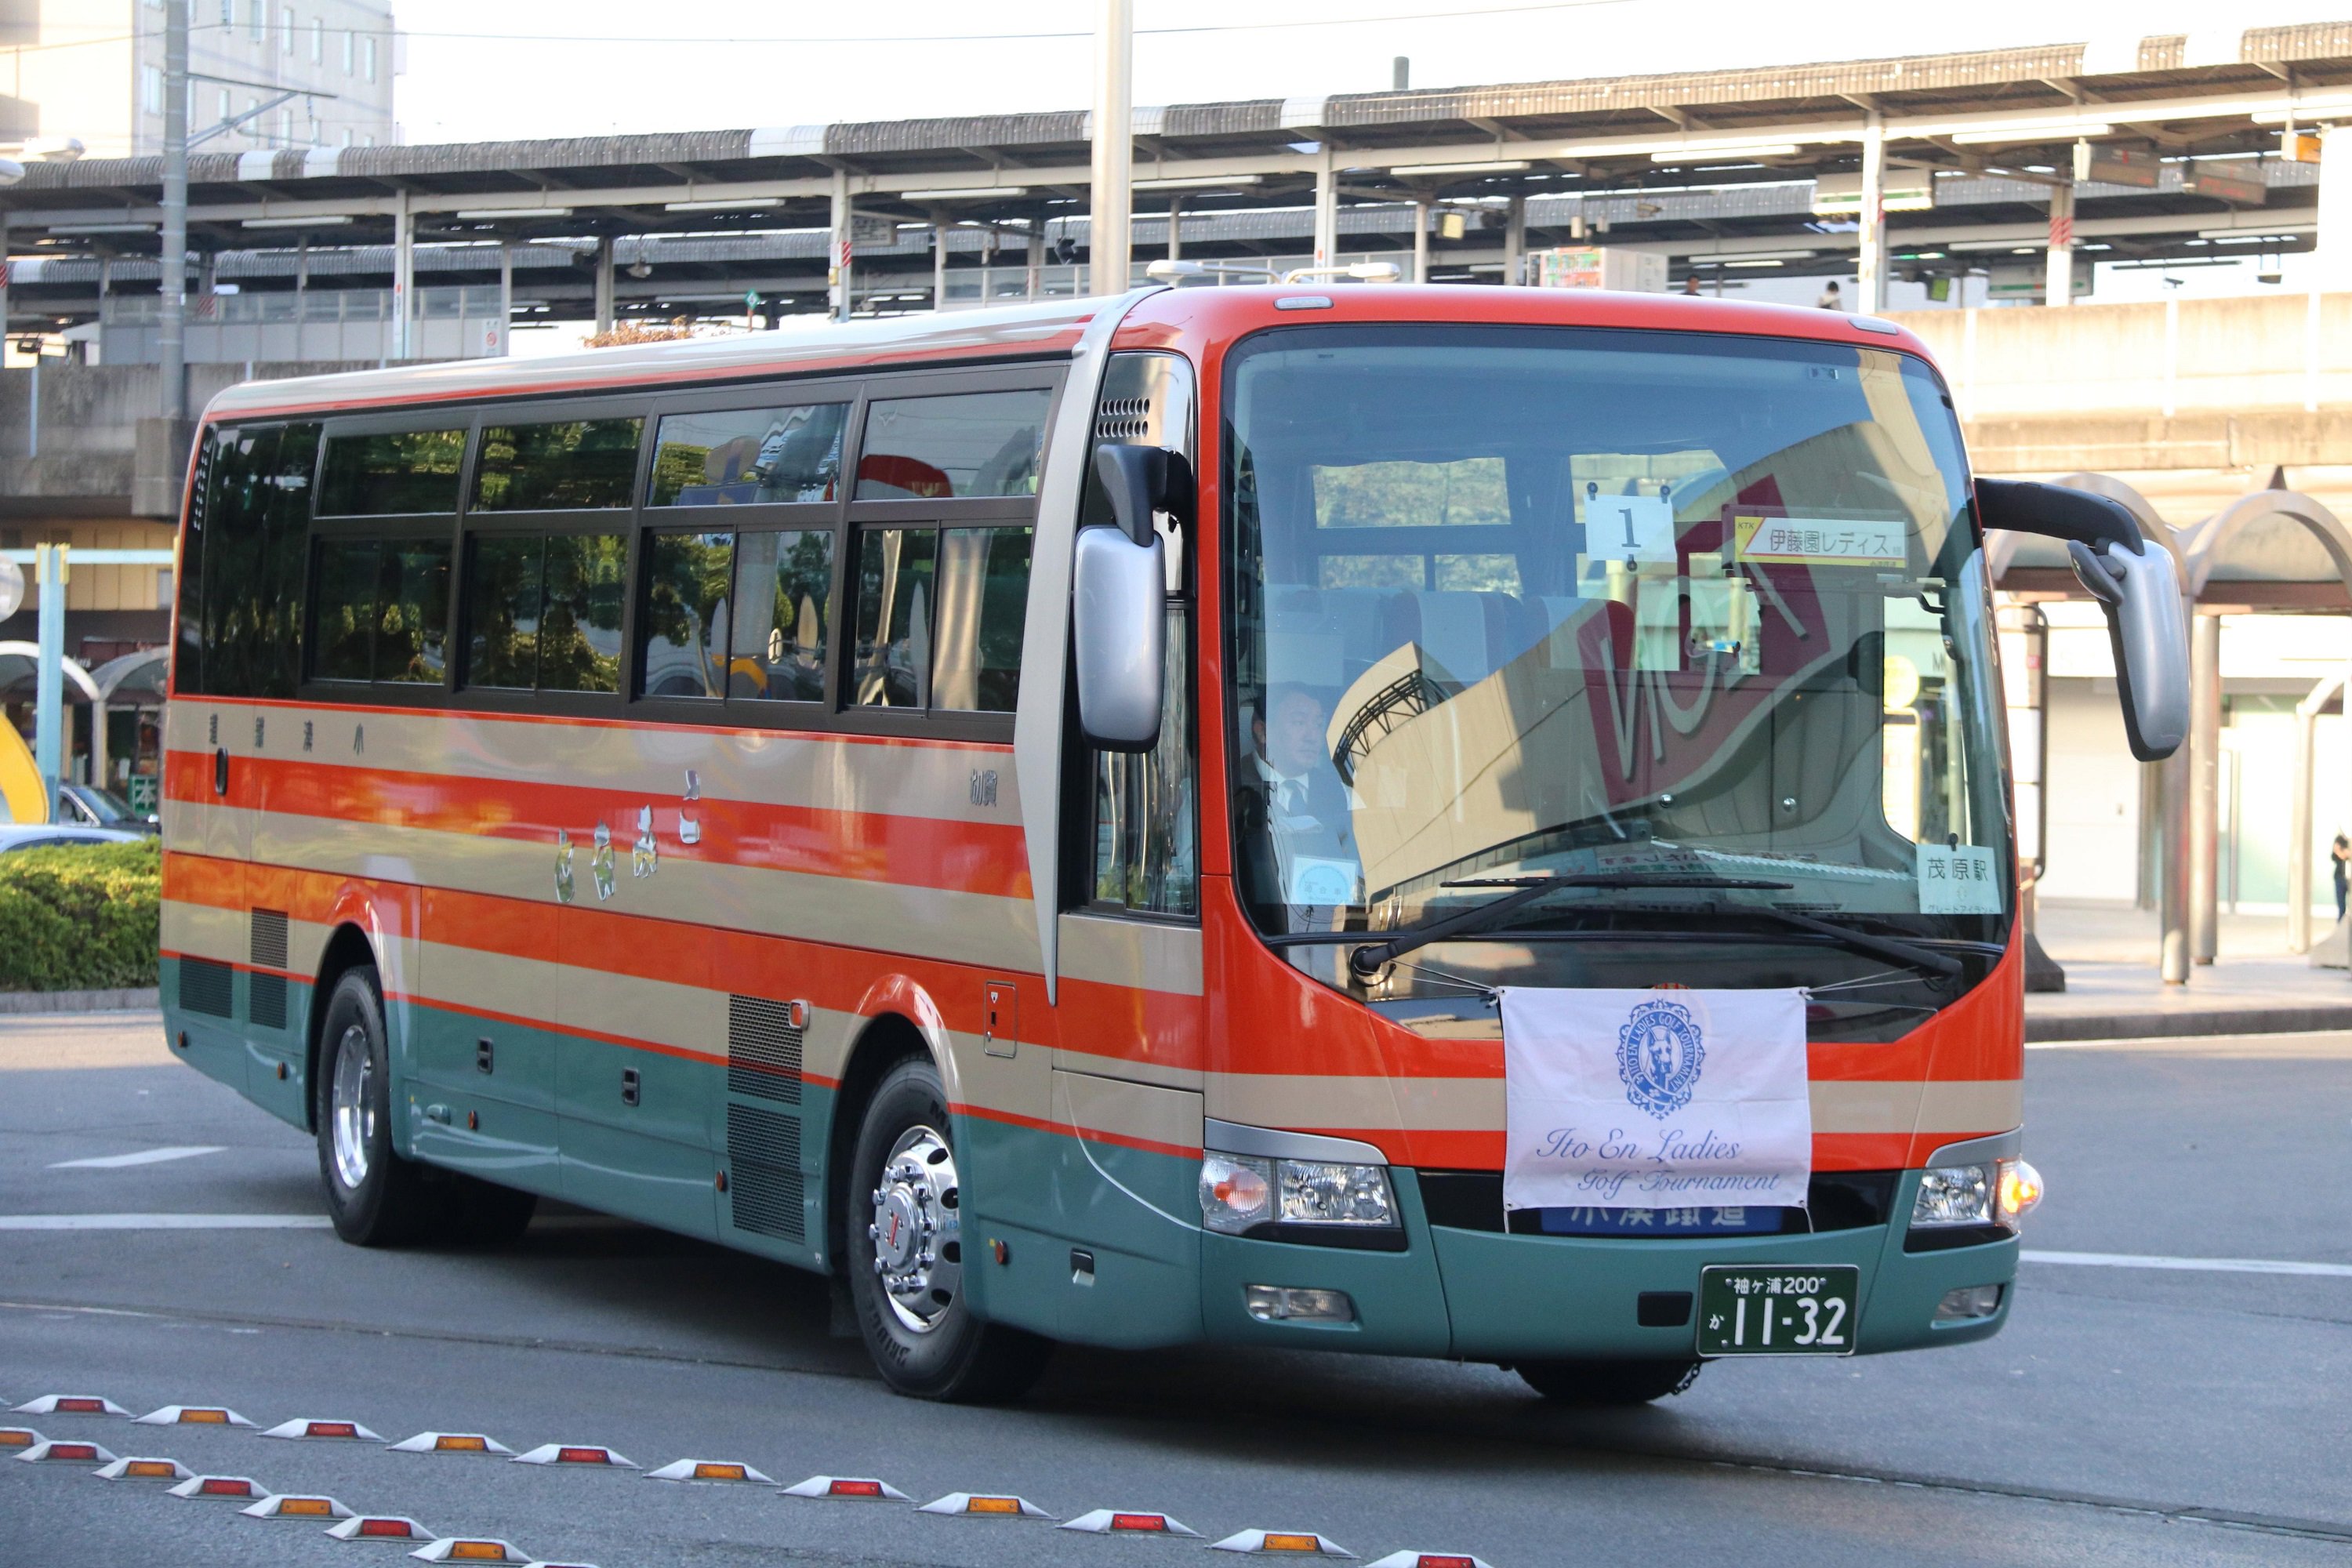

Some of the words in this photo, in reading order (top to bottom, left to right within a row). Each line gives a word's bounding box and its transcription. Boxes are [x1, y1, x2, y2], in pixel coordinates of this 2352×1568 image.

[1617, 507, 1642, 549] 1
[1737, 521, 1755, 530] KTK
[1769, 528, 1889, 555] 伊藤園レディス
[1926, 857, 1989, 881] 茂原駅
[1632, 1014, 1656, 1043] LADIES
[1658, 1014, 1682, 1032] GOLF
[1628, 1043, 1638, 1058] EN
[1670, 1028, 1695, 1091] TOURNAMENT
[1628, 1058, 1640, 1076] ITO
[1537, 1127, 1592, 1159] Ito
[1599, 1128, 1642, 1160] En
[1646, 1129, 1742, 1164] Ladies
[1577, 1167, 1640, 1200] Golf
[1639, 1169, 1780, 1192] Tournament
[1708, 1313, 1725, 1330] か
[1734, 1297, 1847, 1345] 11-32
